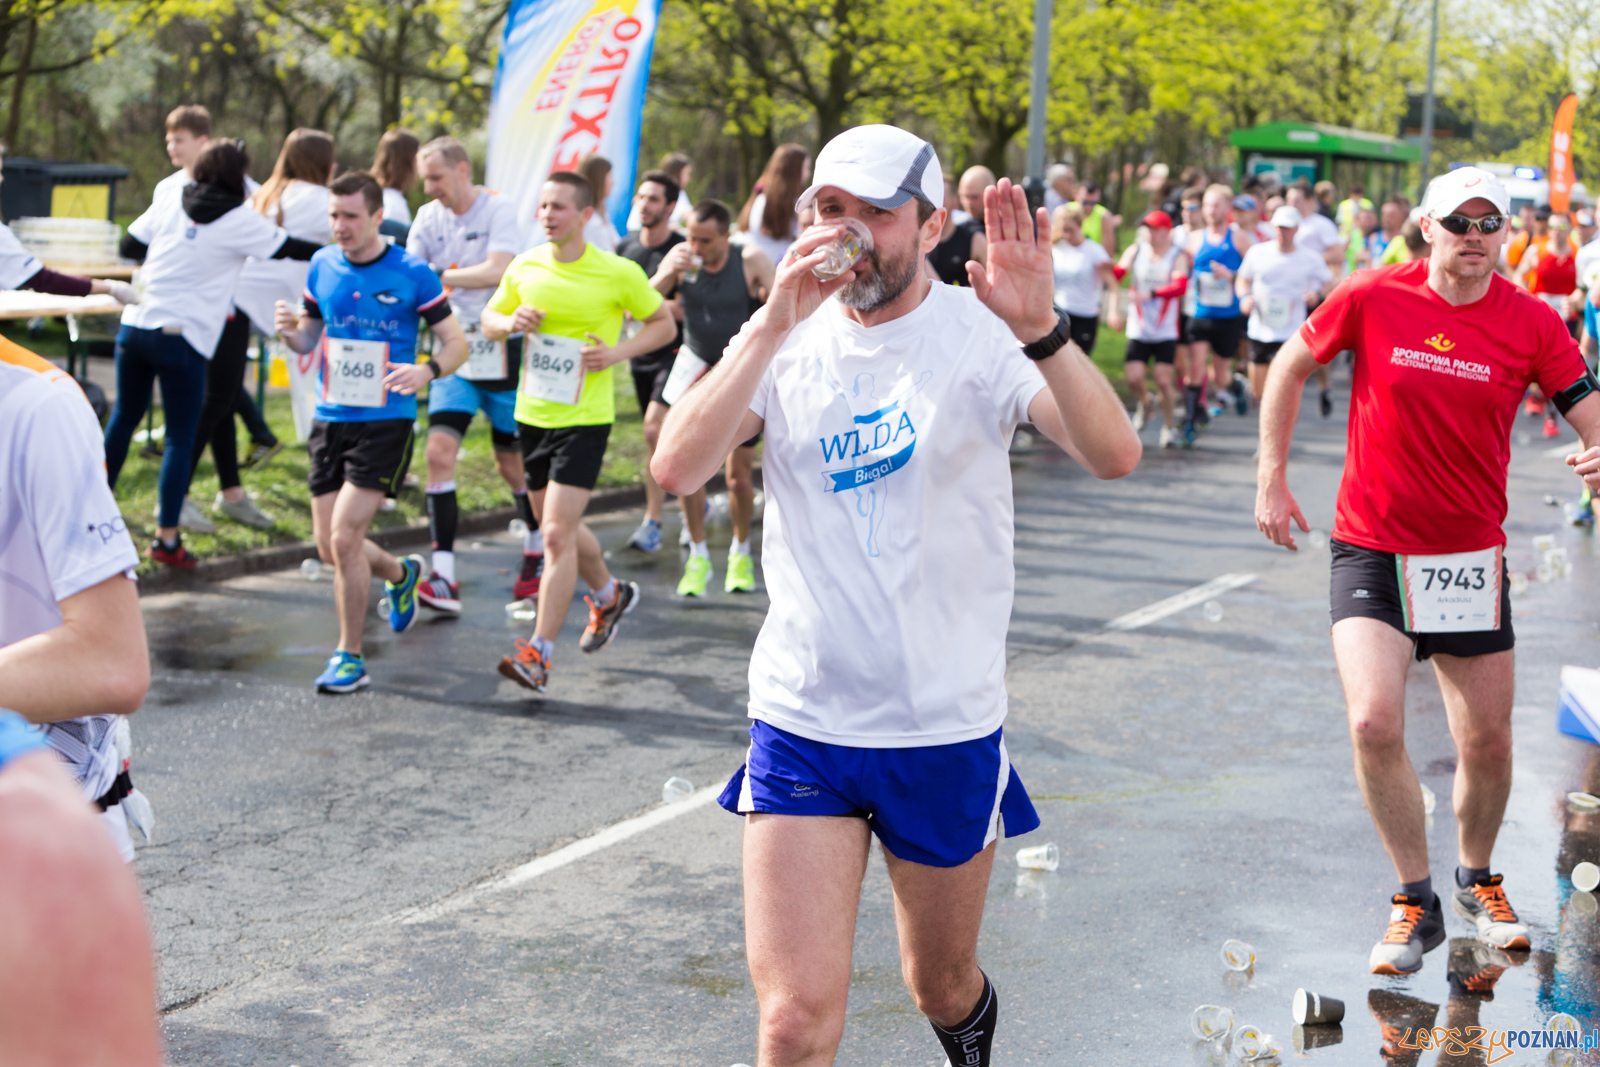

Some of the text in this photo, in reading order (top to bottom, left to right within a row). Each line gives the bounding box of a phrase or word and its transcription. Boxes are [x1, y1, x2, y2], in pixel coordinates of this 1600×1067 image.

[334, 360, 375, 379] 7668
[531, 351, 575, 375] 8849
[1390, 356, 1490, 383] POCZTOWA GRUPA BIEGOWA
[1392, 346, 1491, 376] SPORTOWA PACZKA
[1421, 567, 1485, 591] 7943
